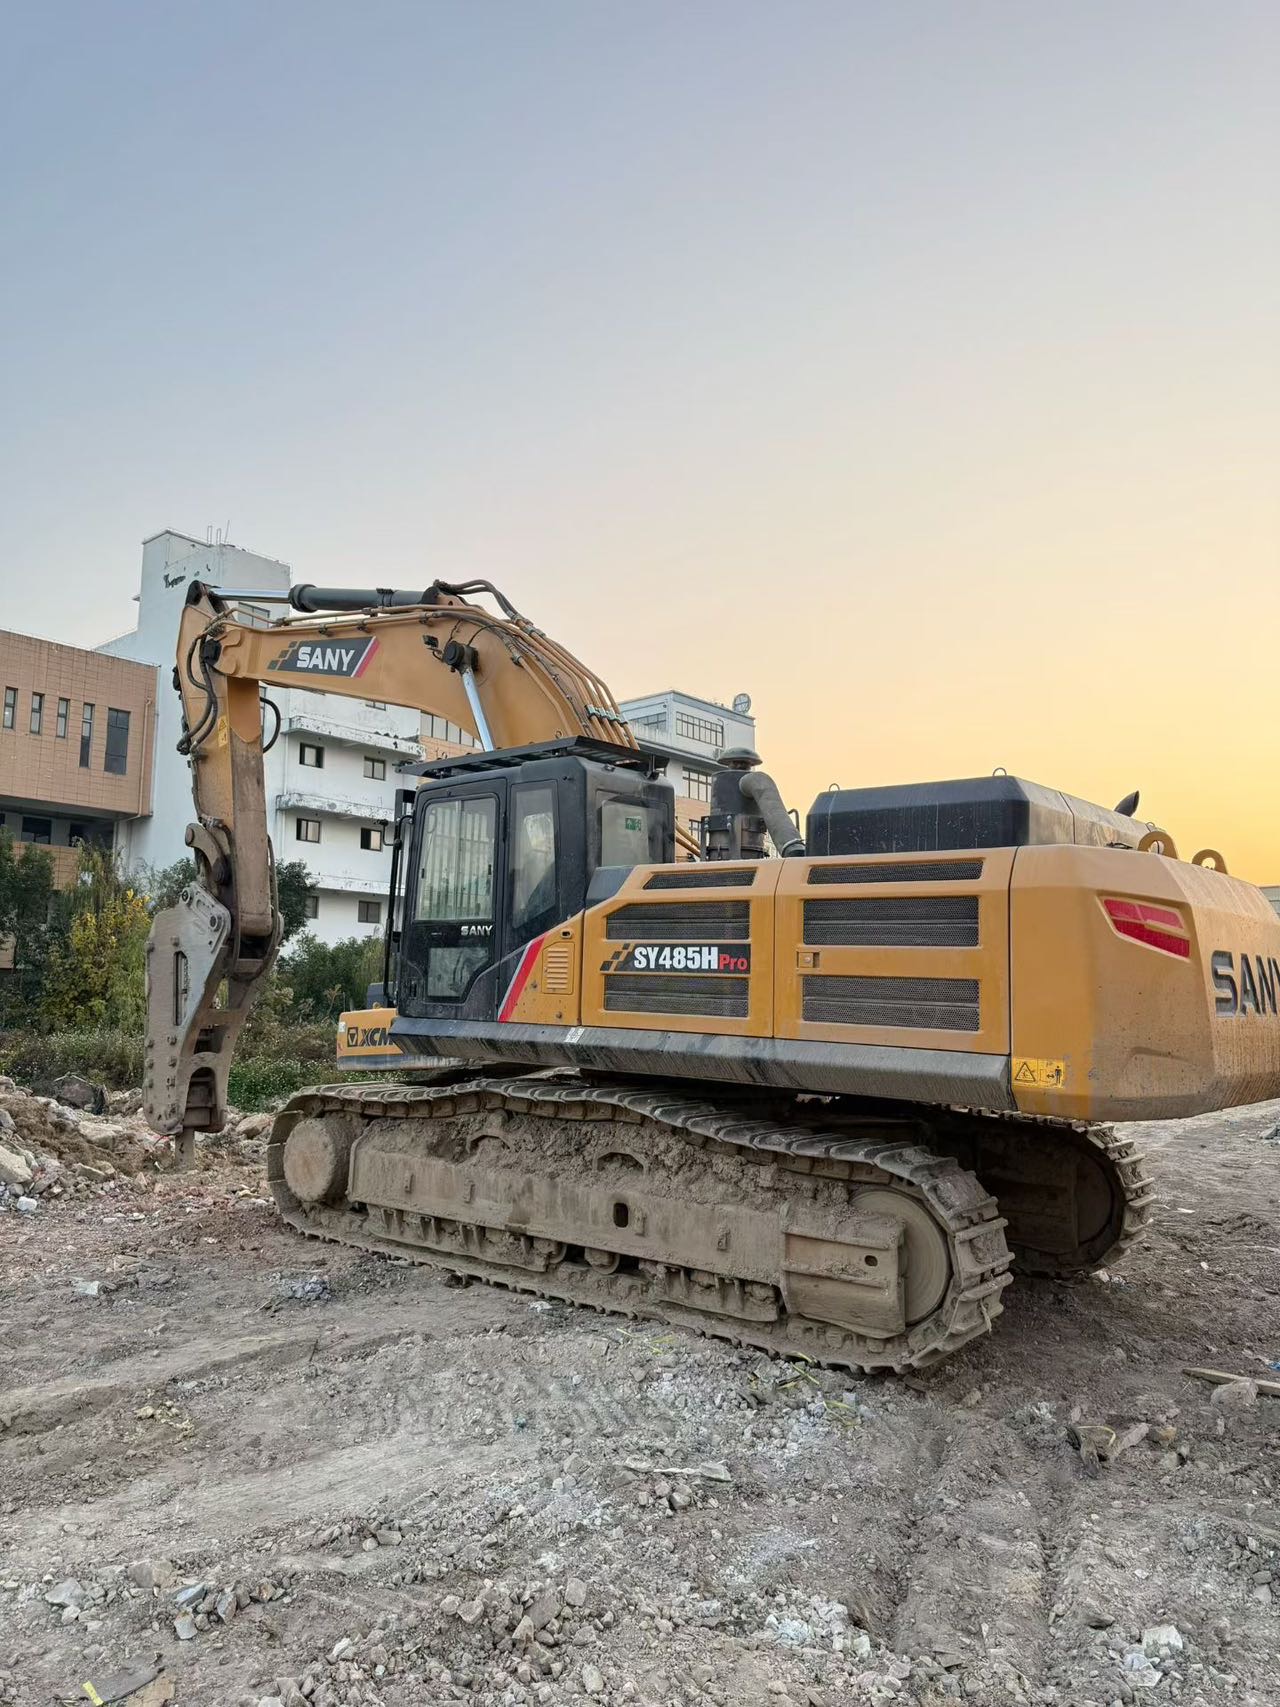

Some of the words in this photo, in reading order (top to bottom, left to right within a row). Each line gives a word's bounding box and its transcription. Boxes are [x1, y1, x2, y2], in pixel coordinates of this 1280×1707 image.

[296, 646, 355, 672] SANY
[460, 925, 492, 936] SANY
[633, 946, 718, 970] SY485H
[719, 953, 748, 971] Pro
[1211, 950, 1280, 1016] SAN
